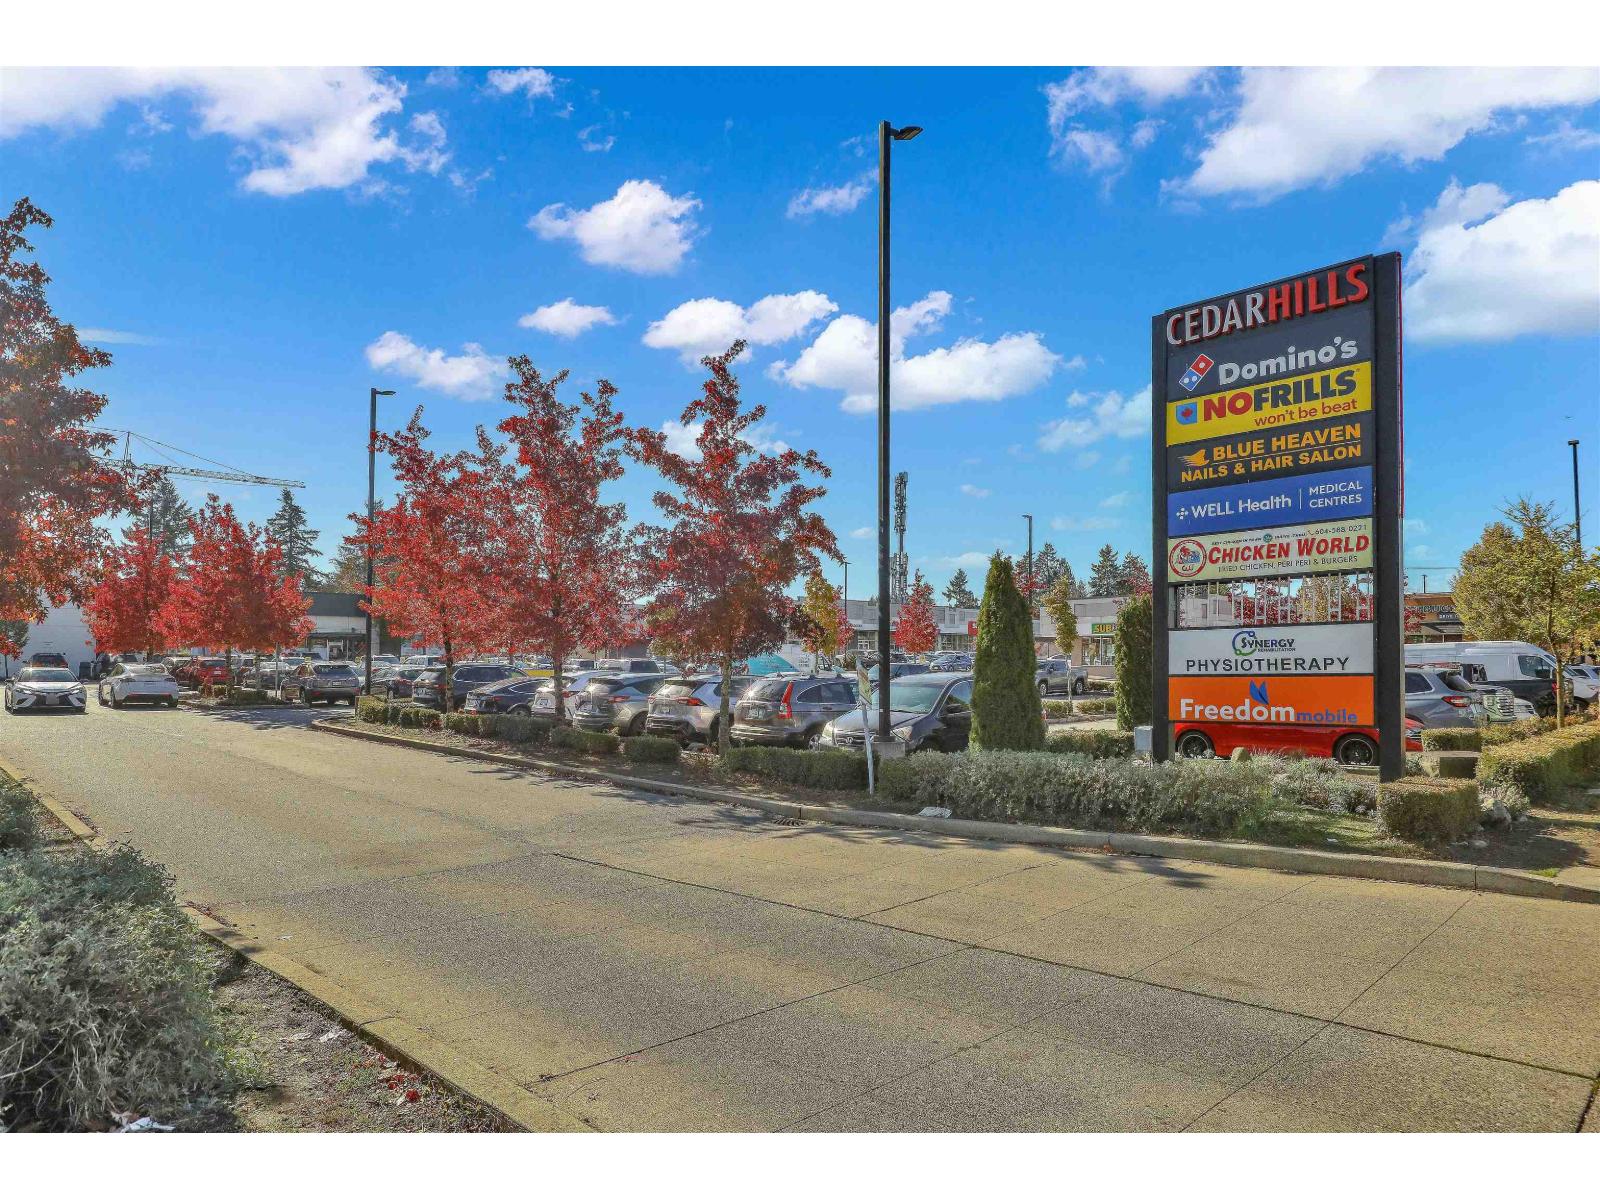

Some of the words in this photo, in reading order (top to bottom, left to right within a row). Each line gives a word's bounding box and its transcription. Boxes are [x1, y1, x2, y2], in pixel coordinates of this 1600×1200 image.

[1218, 336, 1358, 385] Domino's
[1254, 409, 1295, 427] won't
[1299, 404, 1317, 419] be
[1322, 398, 1357, 415] beat
[1213, 439, 1265, 461] BLUE
[1271, 423, 1361, 451] HEAVEN
[1181, 465, 1228, 483] NAILS
[1233, 462, 1246, 475] &
[1251, 455, 1294, 472] HAIR
[1298, 444, 1362, 465] SALON
[1308, 481, 1364, 496] MEDICAL
[1309, 494, 1362, 508] CENTRES
[1191, 501, 1235, 519] WELL
[1238, 494, 1292, 513] Health
[1208, 542, 1291, 565] CHICKEN
[1296, 534, 1370, 557] WORLD
[1295, 558, 1311, 567] PERI
[1321, 555, 1358, 565] BURGERS
[1241, 637, 1295, 648] SYNERGY
[1186, 656, 1350, 672] PHYSIOTHERAPY
